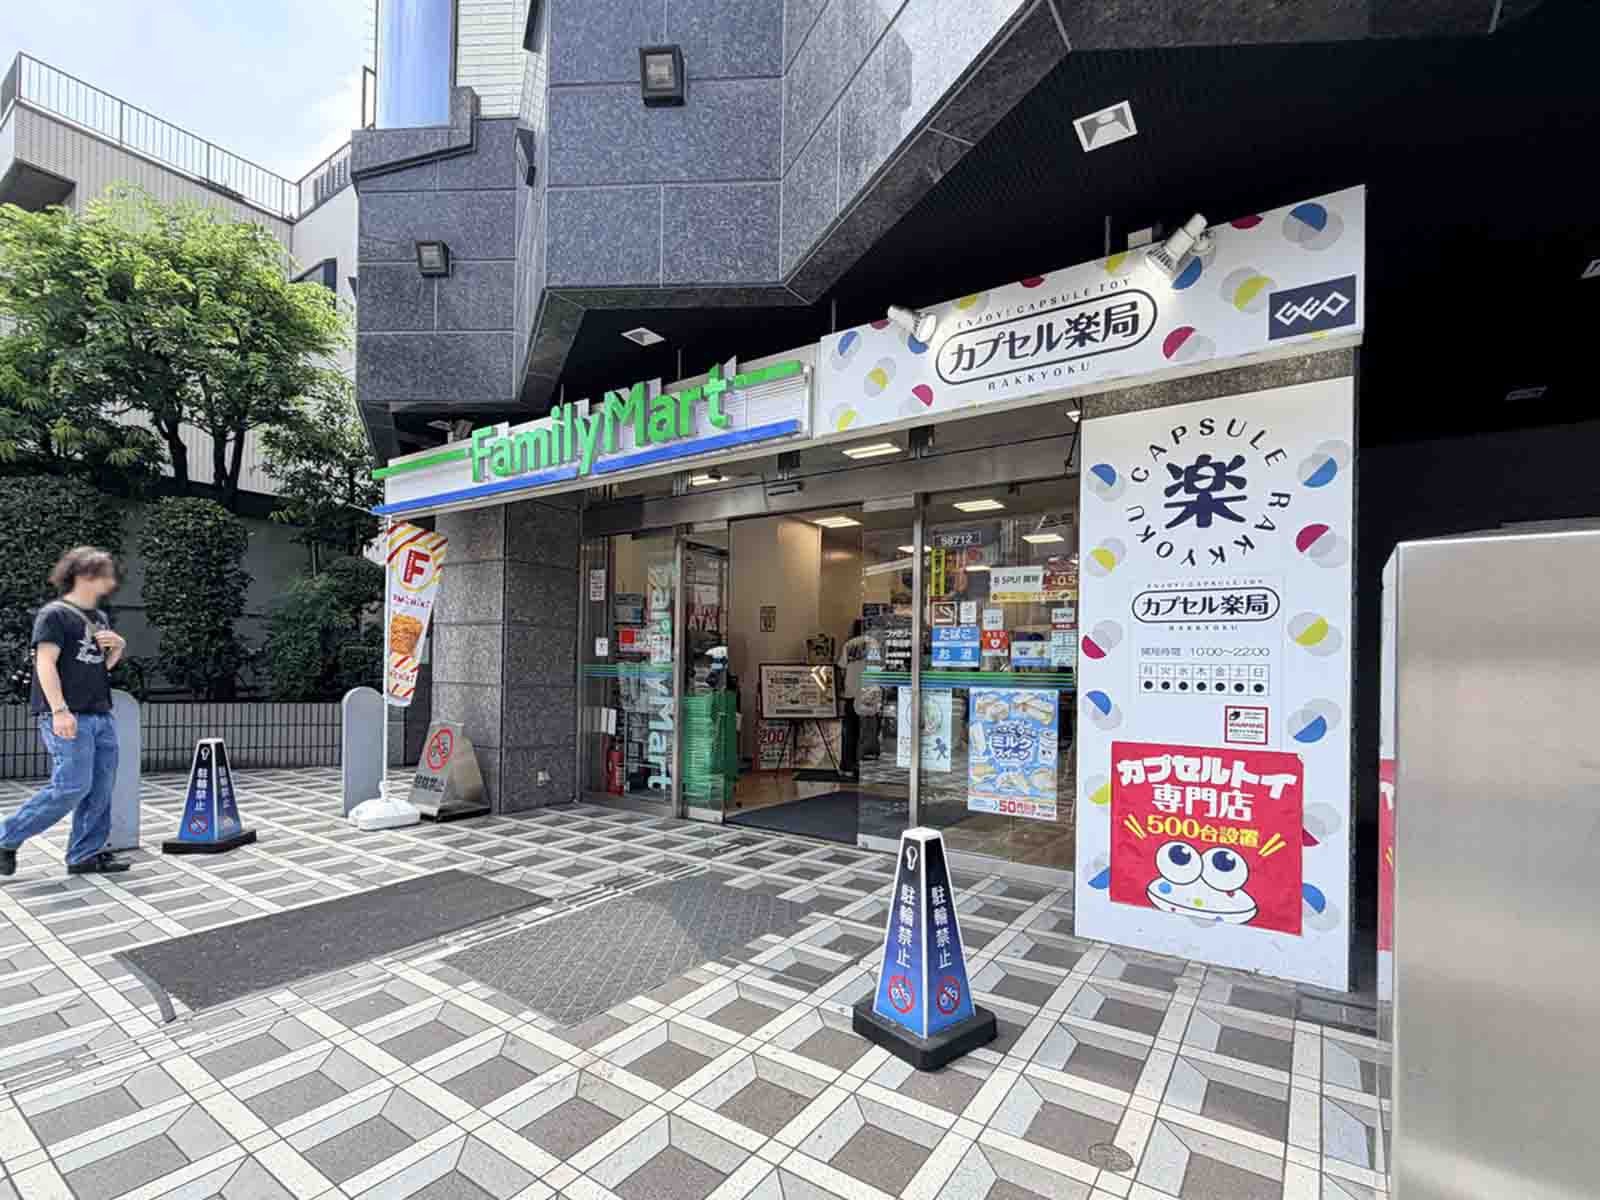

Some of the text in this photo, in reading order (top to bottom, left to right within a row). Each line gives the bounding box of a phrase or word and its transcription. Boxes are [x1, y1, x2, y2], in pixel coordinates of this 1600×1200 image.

[1016, 287, 1091, 315] CAPSULE
[1099, 276, 1132, 290] TOY
[1274, 290, 1350, 327] GEO
[949, 299, 1140, 377] カプセル楽局
[986, 360, 1091, 391] RAKKYOKU
[472, 363, 732, 483] FamilyMart
[1126, 417, 1292, 568] CAPSULE RAKKYOKU
[1163, 454, 1248, 529] 楽
[403, 549, 431, 584] F
[688, 615, 717, 632] ATM
[1141, 594, 1269, 616] カプセル楽局
[939, 628, 976, 641] たばこ
[992, 735, 1033, 750] ミルク
[1116, 753, 1297, 801] カプセルトイ
[1151, 784, 1256, 822] 専門店
[1146, 815, 1261, 849] 500台設置
[896, 884, 917, 969] 駐輪禁止
[931, 886, 953, 970] 駐輪禁止
